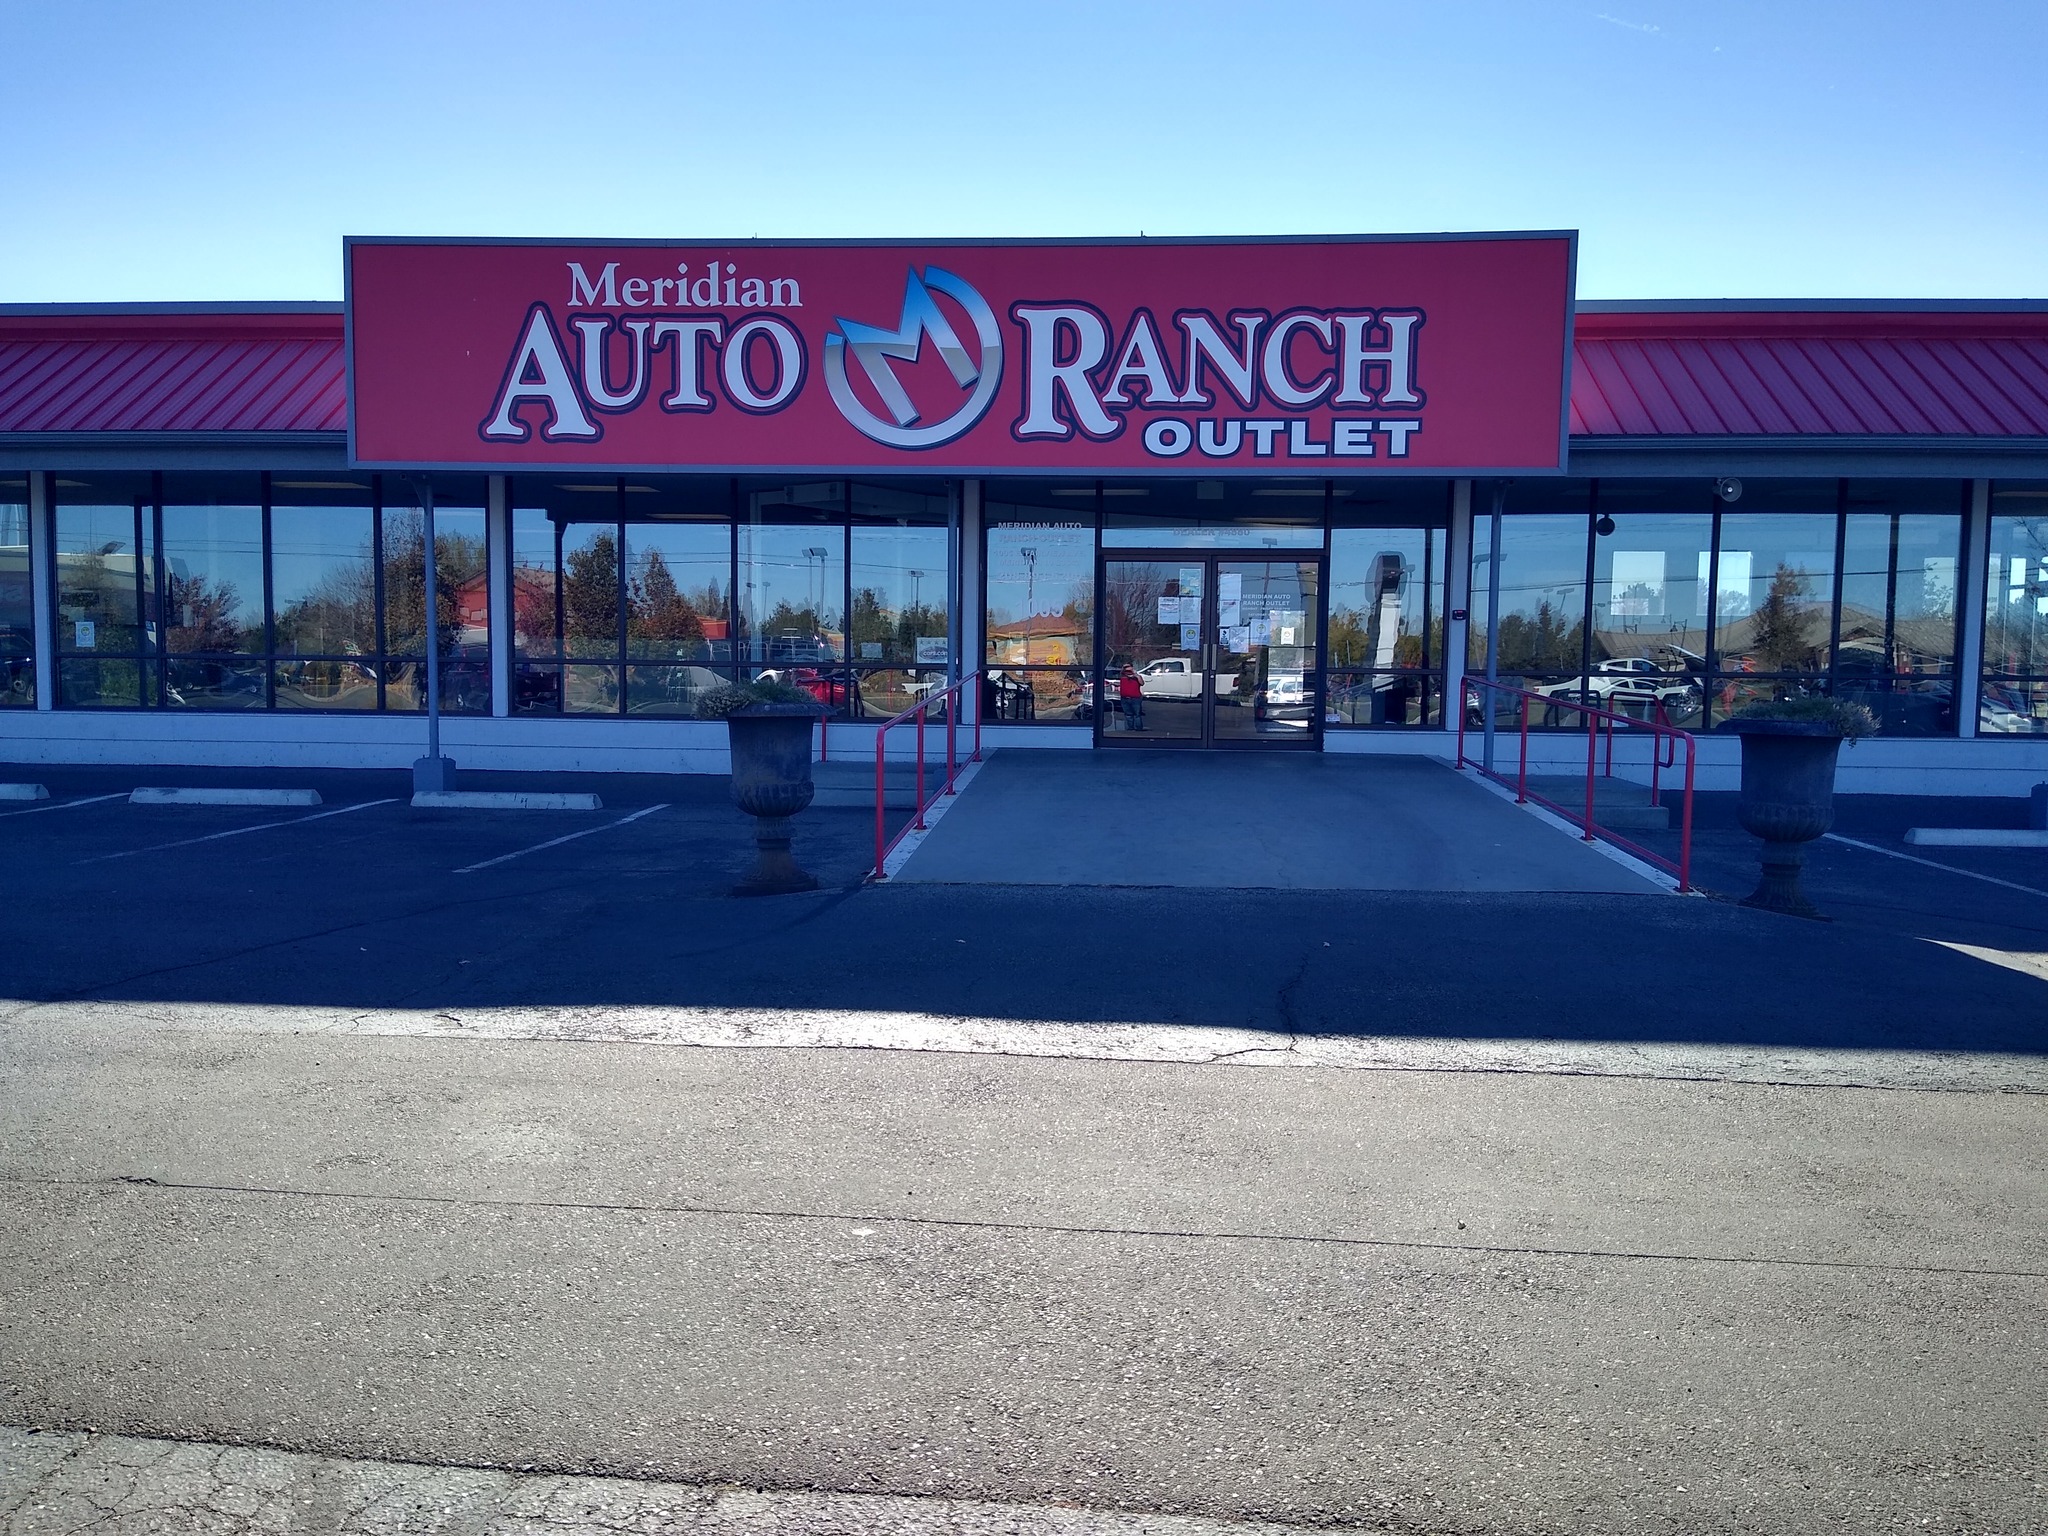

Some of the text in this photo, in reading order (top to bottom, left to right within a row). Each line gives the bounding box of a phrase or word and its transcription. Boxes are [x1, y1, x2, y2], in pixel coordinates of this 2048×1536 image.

[566, 260, 803, 308] Meridian
[484, 307, 803, 437] AUTO
[1015, 307, 1420, 435] RANCH
[1143, 419, 1421, 456] OUTLET
[997, 522, 1082, 531] MERIDIAN AUTO
